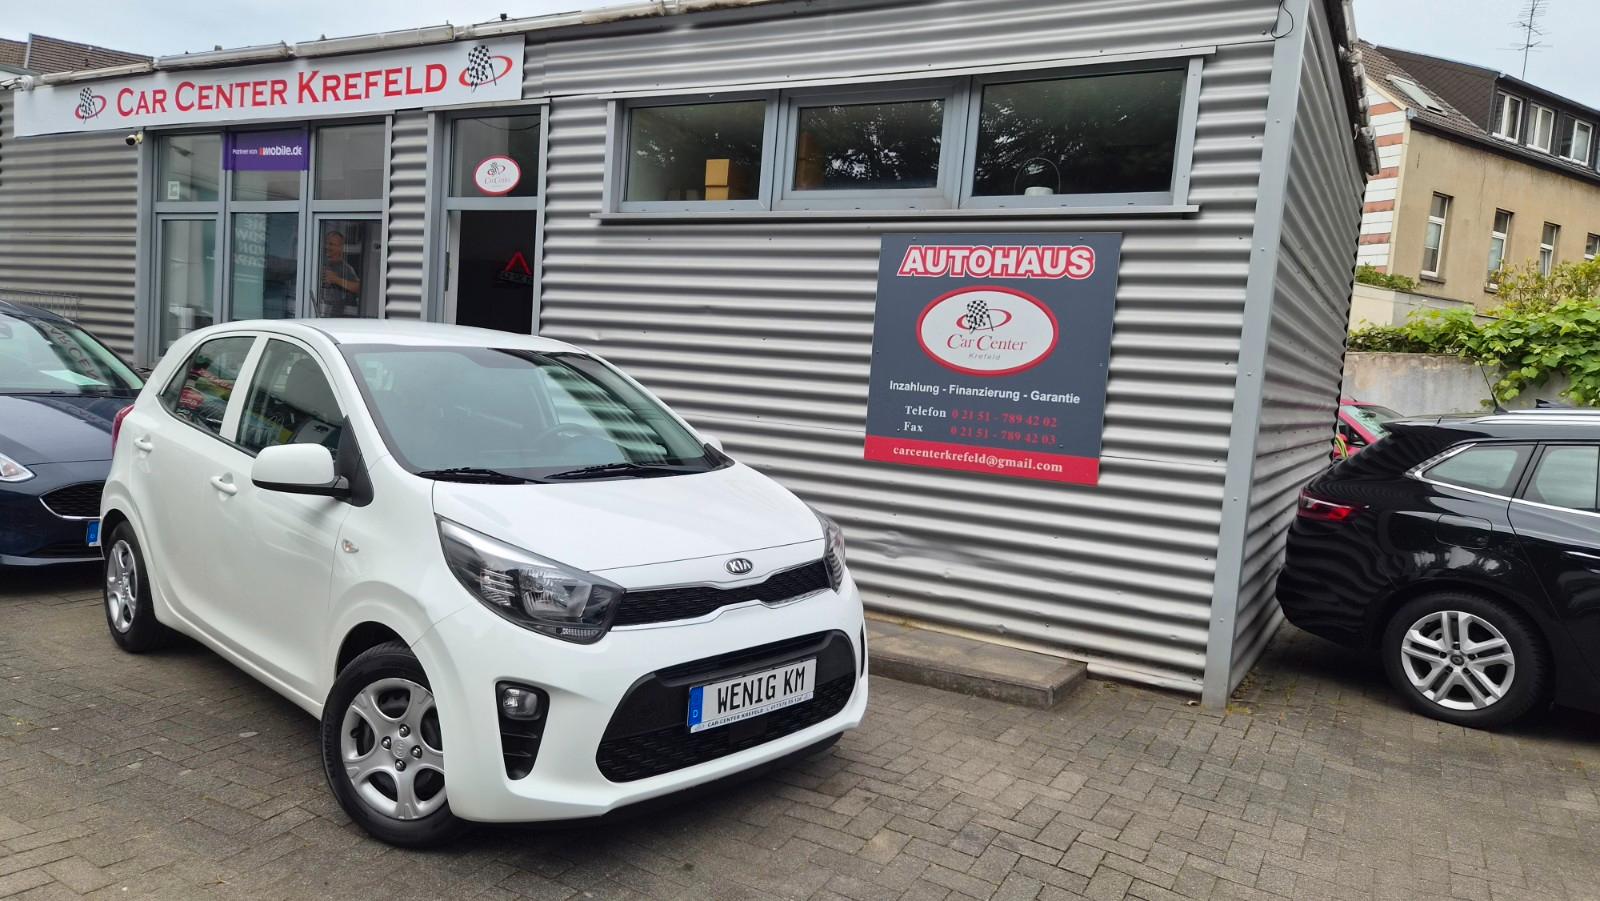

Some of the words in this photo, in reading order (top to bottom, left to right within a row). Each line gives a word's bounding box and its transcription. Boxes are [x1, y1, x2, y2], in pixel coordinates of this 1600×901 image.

[117, 86, 168, 117] CAR
[176, 79, 288, 112] CENTER
[298, 63, 448, 106] KREFELD
[896, 244, 1096, 280] AUTOHAUS
[946, 333, 975, 351] Car
[976, 334, 1028, 351] Center
[889, 380, 940, 395] Inzahlung
[948, 384, 1020, 402] Finanzierung
[1030, 390, 1081, 405] Garantie
[905, 405, 947, 418] Telefon
[903, 421, 923, 433] Fax
[893, 446, 1063, 473] carcenterkrefeld@gmail.com
[729, 559, 751, 572] KIA
[717, 674, 777, 714] WENIG
[784, 666, 806, 695] KM
